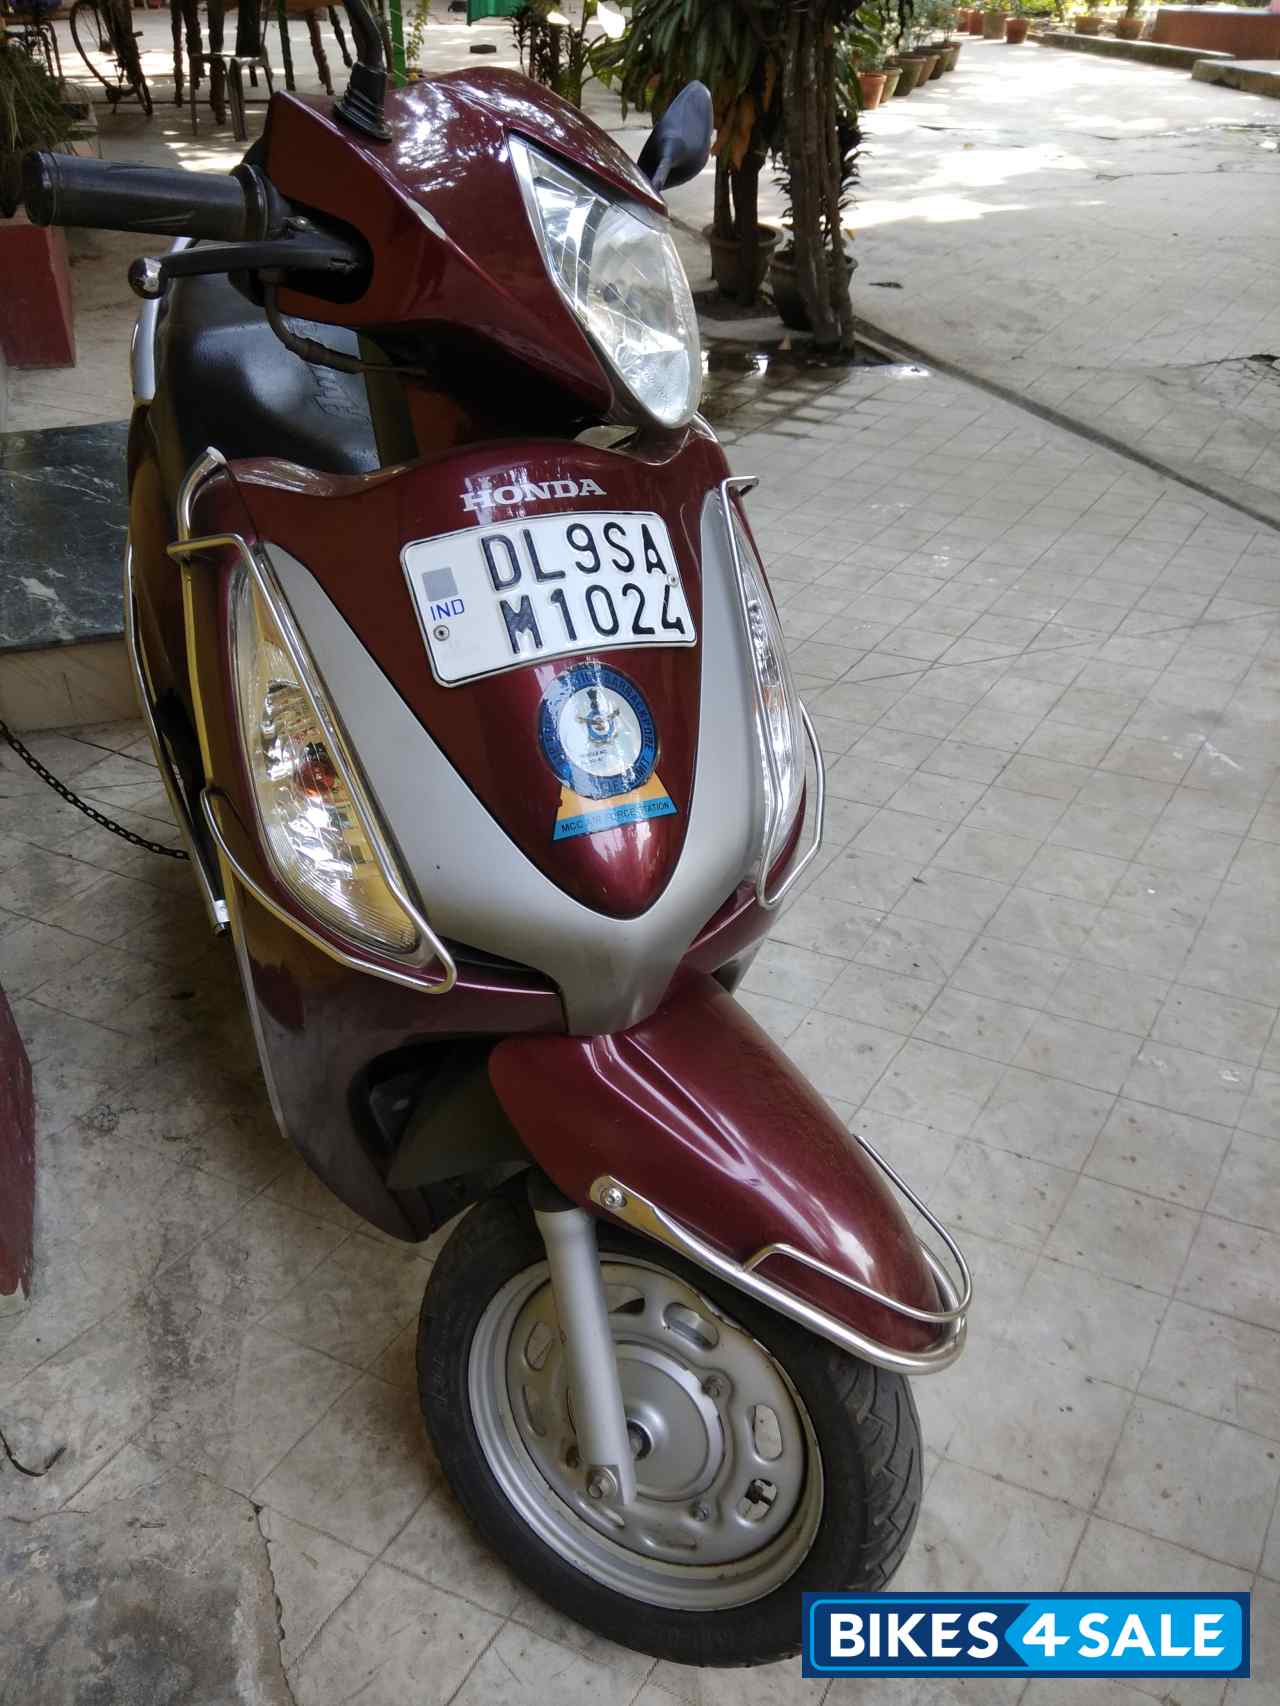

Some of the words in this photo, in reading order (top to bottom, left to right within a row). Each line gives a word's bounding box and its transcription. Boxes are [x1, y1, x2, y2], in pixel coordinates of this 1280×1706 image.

[460, 478, 607, 512] HONDA
[430, 598, 465, 622] IND
[499, 583, 686, 654] M1024
